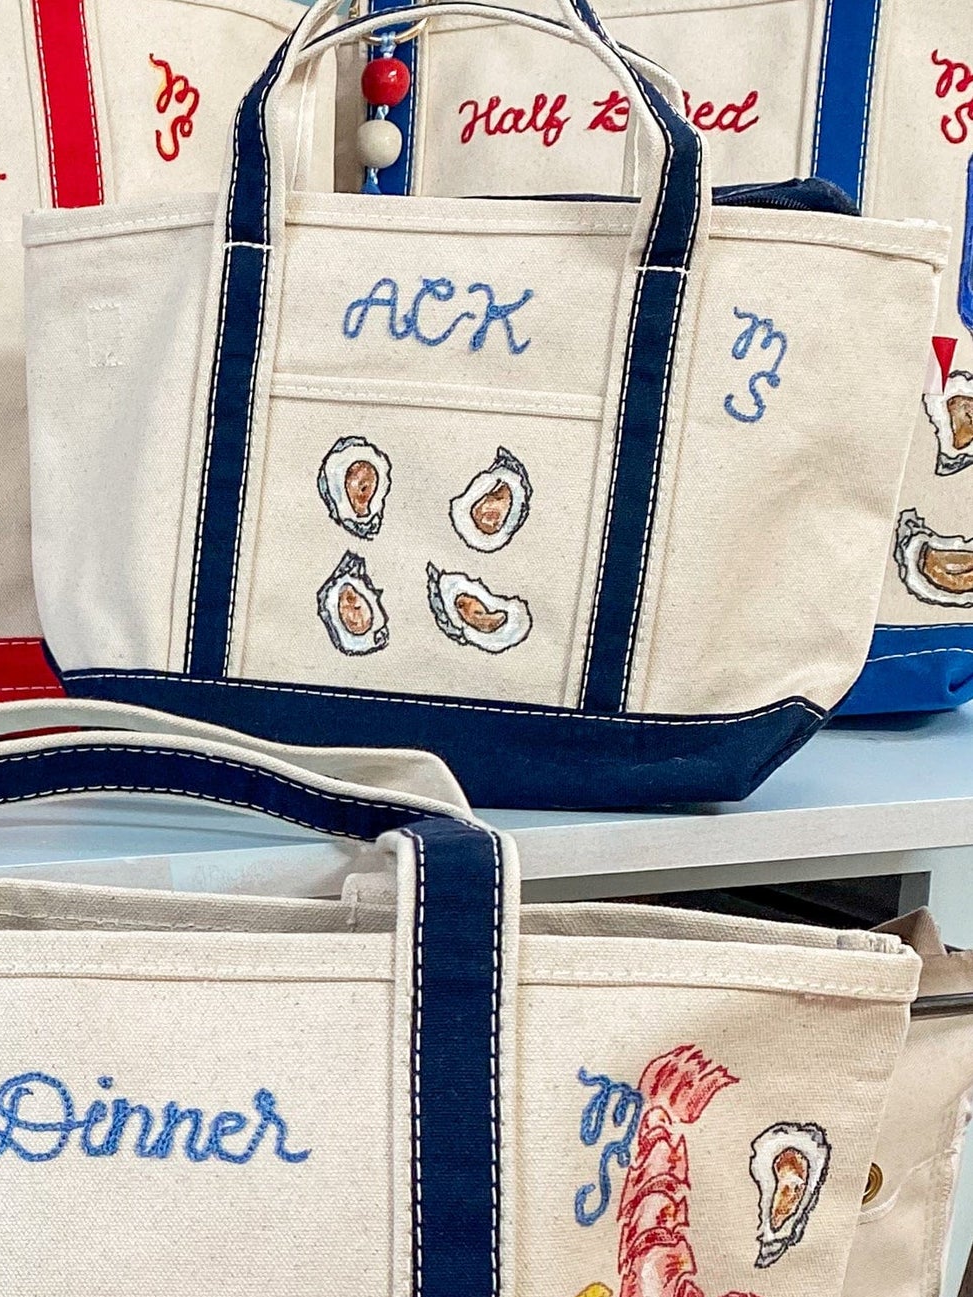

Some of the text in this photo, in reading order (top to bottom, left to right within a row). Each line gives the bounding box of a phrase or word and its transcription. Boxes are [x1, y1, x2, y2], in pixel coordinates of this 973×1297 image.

[458, 89, 759, 146] Half Bed
[342, 276, 535, 355] ACK
